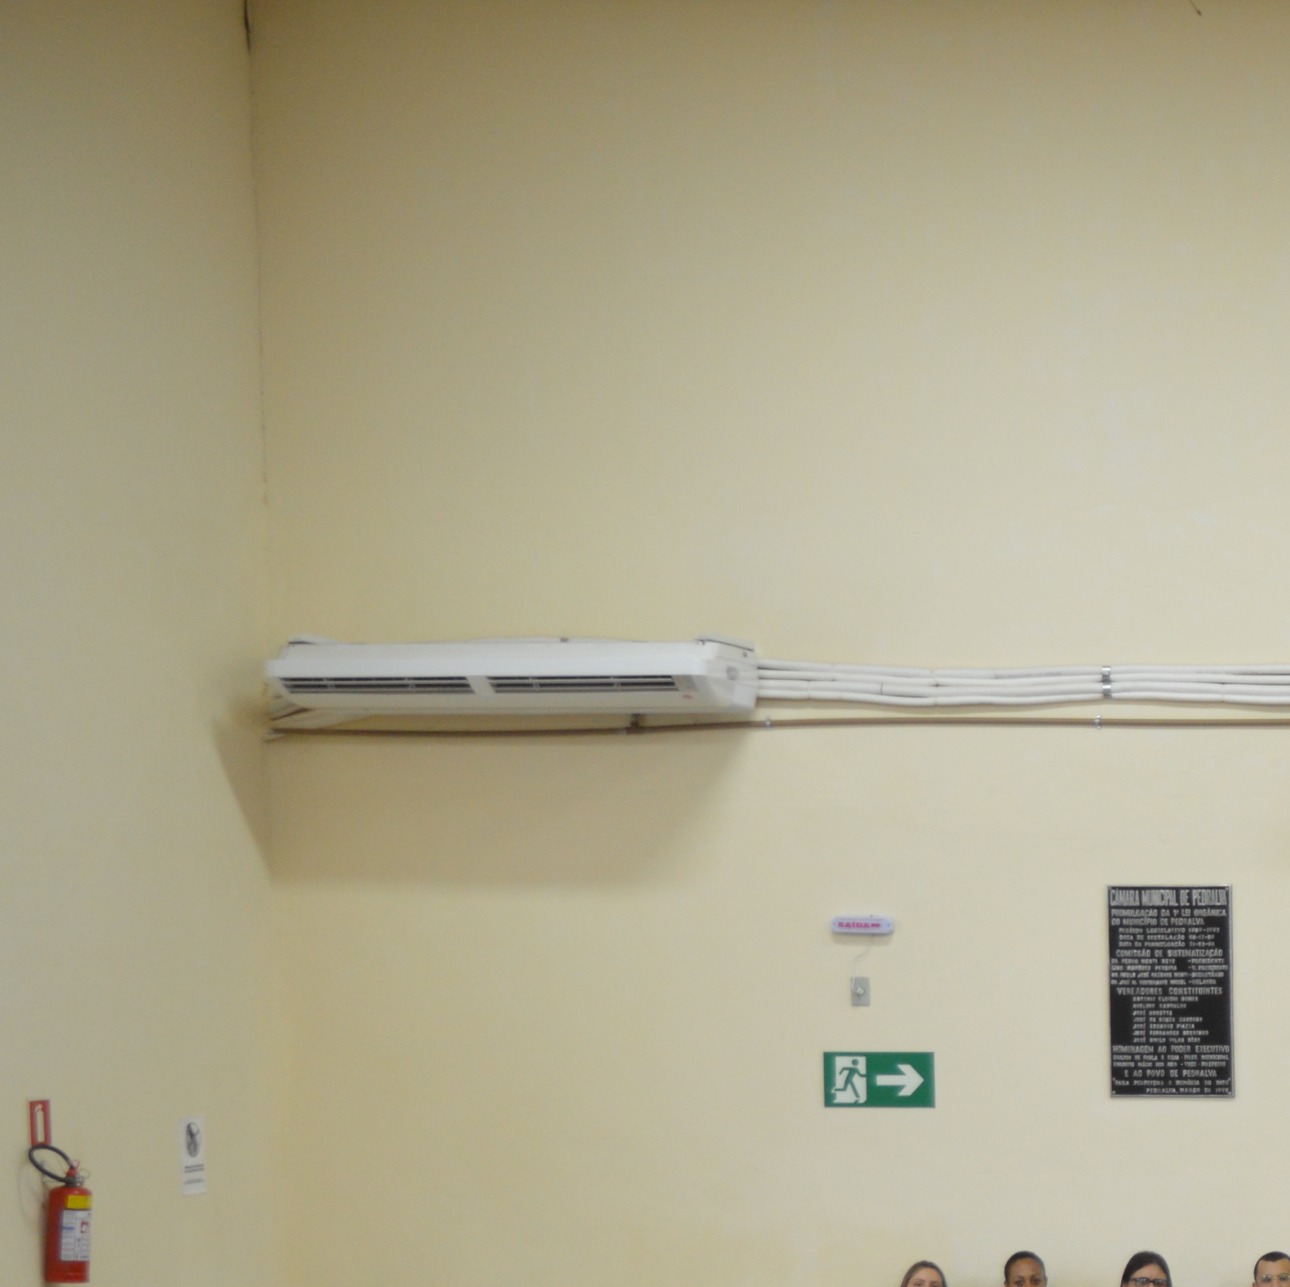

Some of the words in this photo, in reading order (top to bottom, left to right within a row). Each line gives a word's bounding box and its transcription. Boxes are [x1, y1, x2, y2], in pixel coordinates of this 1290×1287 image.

[1141, 889, 1178, 906] MUNICIPAL
[1180, 890, 1190, 905] DE
[1192, 889, 1227, 906] PEDRALVA
